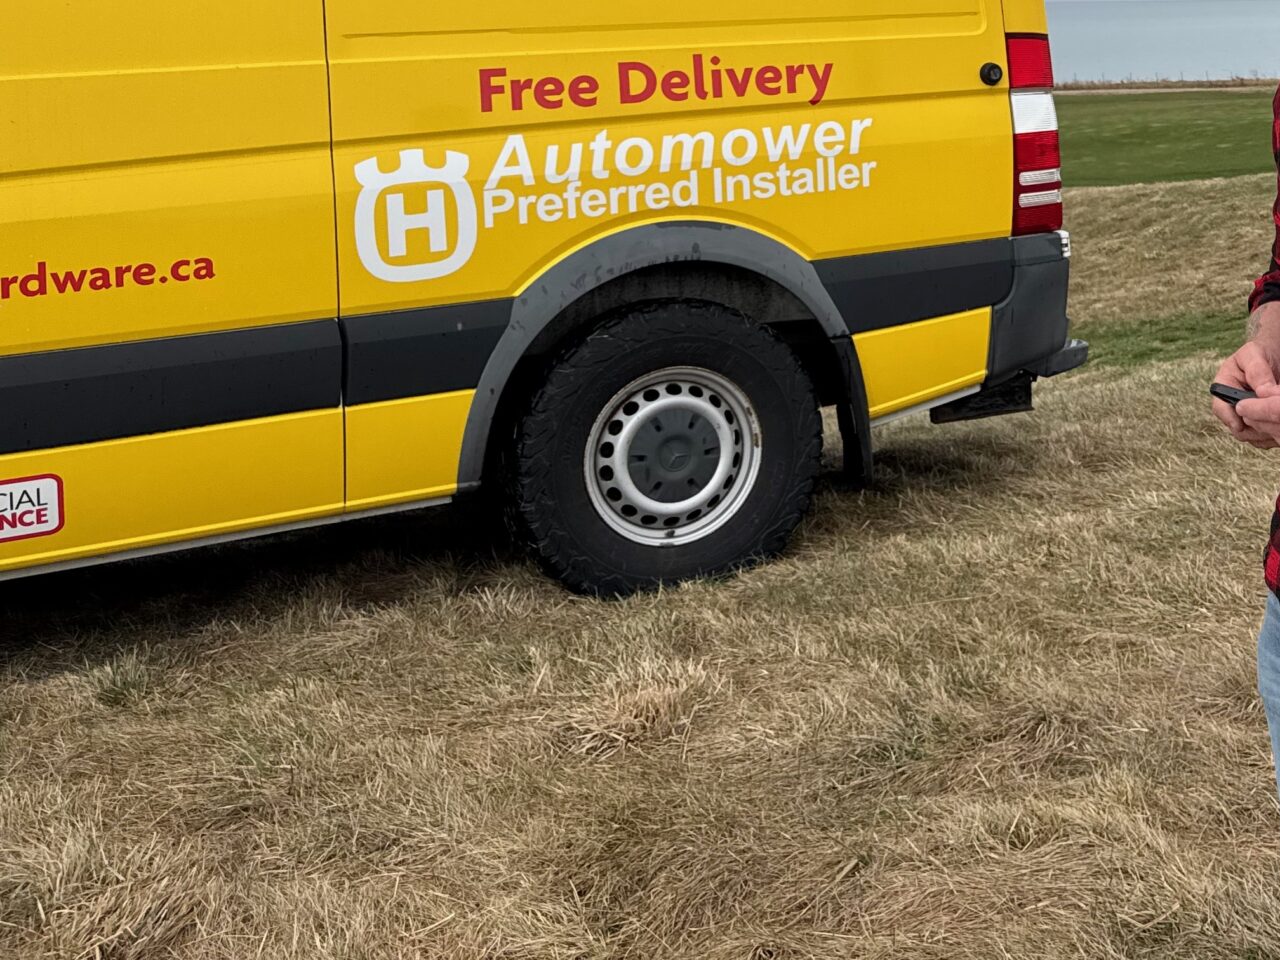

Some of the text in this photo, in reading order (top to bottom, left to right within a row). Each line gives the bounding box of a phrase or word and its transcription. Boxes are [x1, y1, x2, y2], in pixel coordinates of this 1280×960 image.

[478, 53, 833, 113] Free Delivery
[482, 117, 873, 191] Automower
[482, 157, 877, 229] Preferred Installer
[0, 257, 215, 300] rdware.ca
